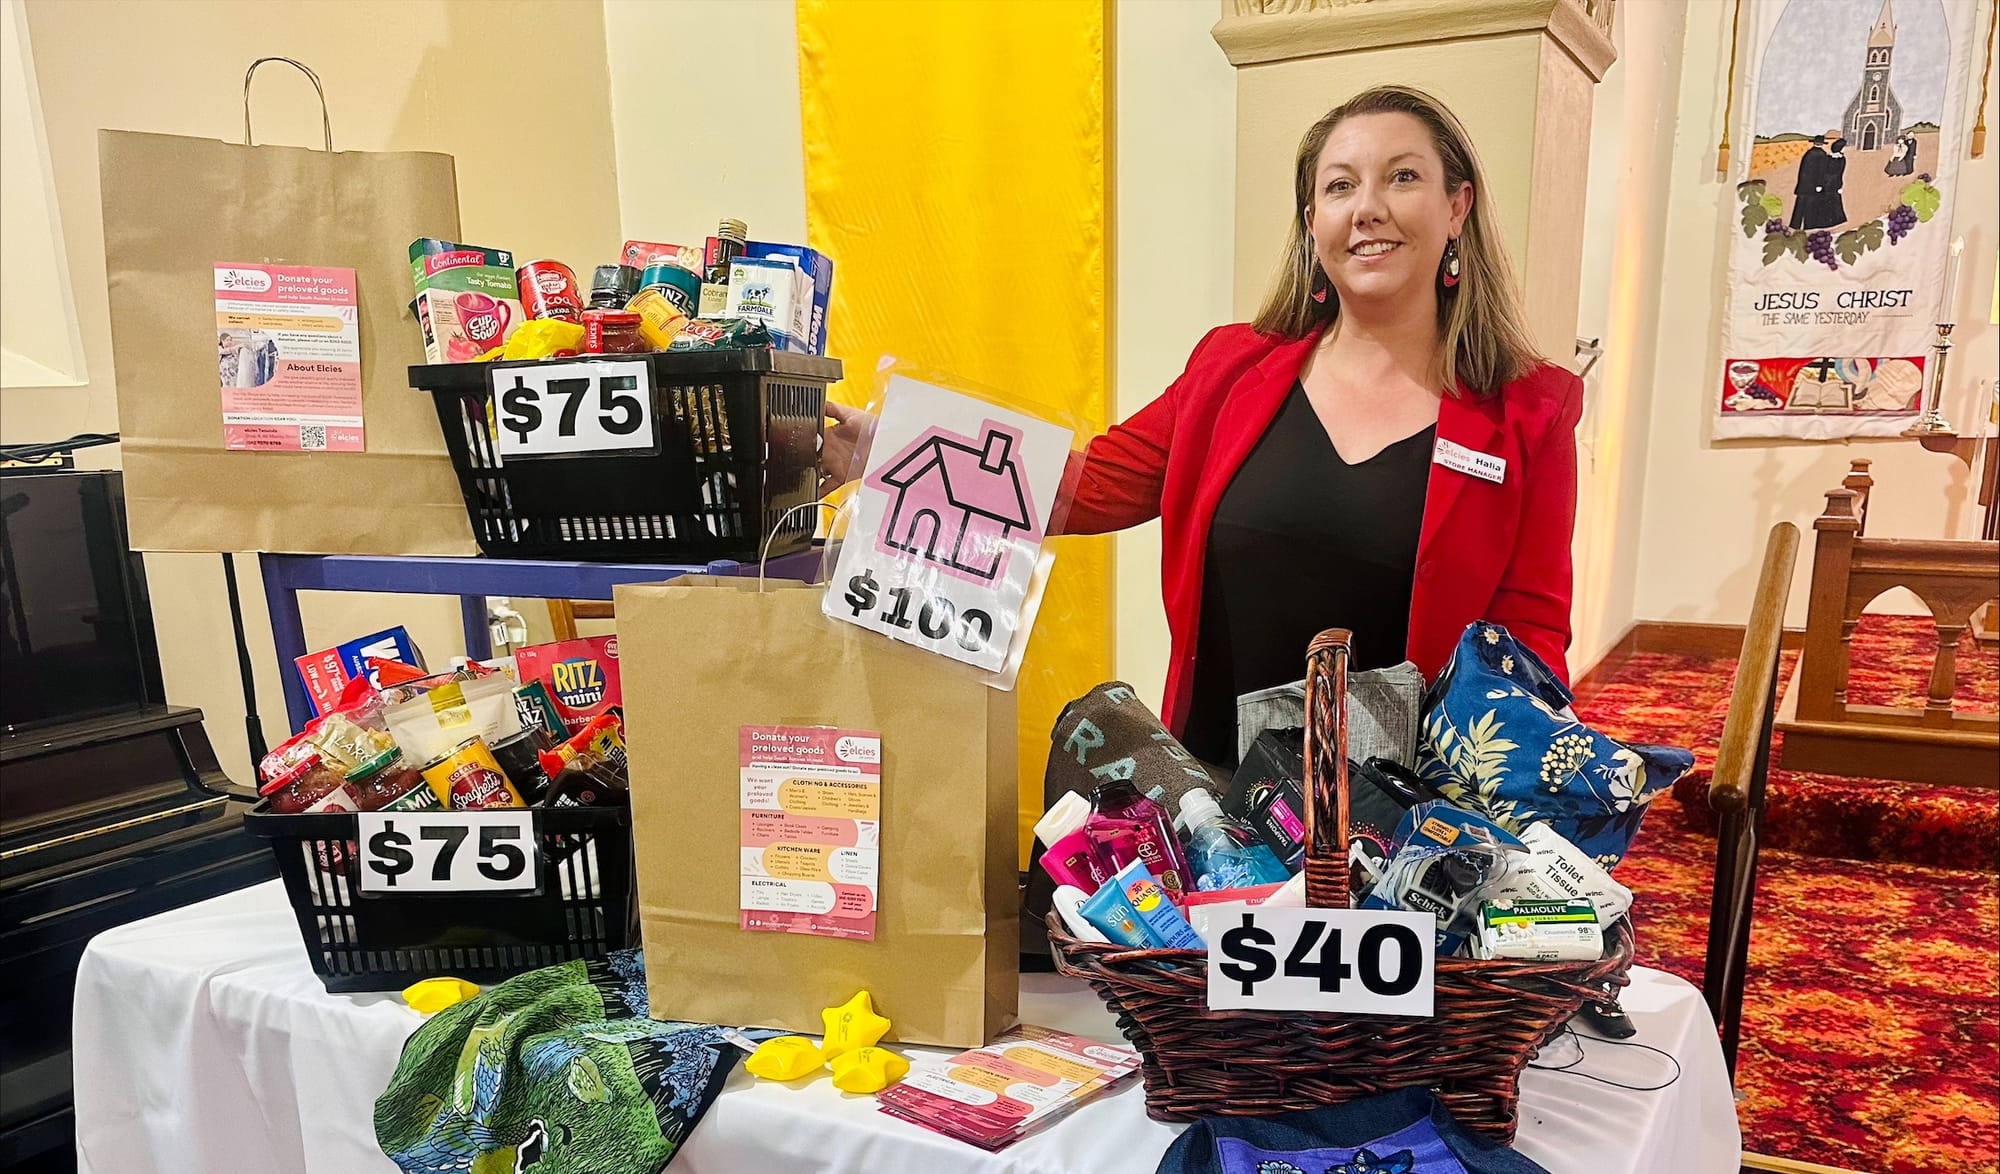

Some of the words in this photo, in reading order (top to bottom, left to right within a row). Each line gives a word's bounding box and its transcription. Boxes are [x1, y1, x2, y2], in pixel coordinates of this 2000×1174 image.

[431, 254, 480, 270] Continental
[235, 276, 266, 286] elcies
[278, 274, 310, 284] Donate
[312, 276, 333, 286] your
[278, 284, 318, 294] preloved
[320, 288, 348, 296] goods
[466, 276, 484, 288] Tasty
[486, 280, 512, 289] Tomato
[738, 305, 774, 316] FARMDALE
[1754, 292, 1820, 311] JESUS
[1837, 290, 1912, 308] CHRIST
[469, 314, 493, 329] CUP
[1762, 313, 1780, 326] THE
[1783, 312, 1810, 324] SAME
[1814, 311, 1870, 325] YESTERDAY
[472, 320, 498, 340] SOUP
[590, 321, 598, 349] SAUCES
[287, 364, 314, 372] About
[317, 364, 342, 373] Elcies
[502, 376, 644, 444] $75
[1444, 459, 1465, 470] STORE
[1468, 467, 1502, 480] MANAGER
[1445, 448, 1470, 462] elcies
[1476, 458, 1501, 472] Halia
[845, 568, 992, 652] $100
[552, 660, 602, 692] RITZ
[562, 686, 602, 706] mini
[752, 732, 786, 742] Donate
[789, 735, 810, 744] your
[752, 742, 794, 753] preloved
[796, 746, 824, 755] goods
[850, 746, 876, 756] elcies
[452, 771, 498, 809] Spaghetti
[1266, 818, 1289, 848] TAMPONS
[368, 820, 526, 886] $75
[1555, 855, 1584, 884] Toilet
[1546, 864, 1578, 897] Tissue
[1132, 884, 1162, 907] QUASUN
[1408, 892, 1448, 920] Schick
[1107, 904, 1130, 928] sun
[1514, 906, 1567, 914] PALMOLIVE
[1220, 913, 1422, 996] $40
